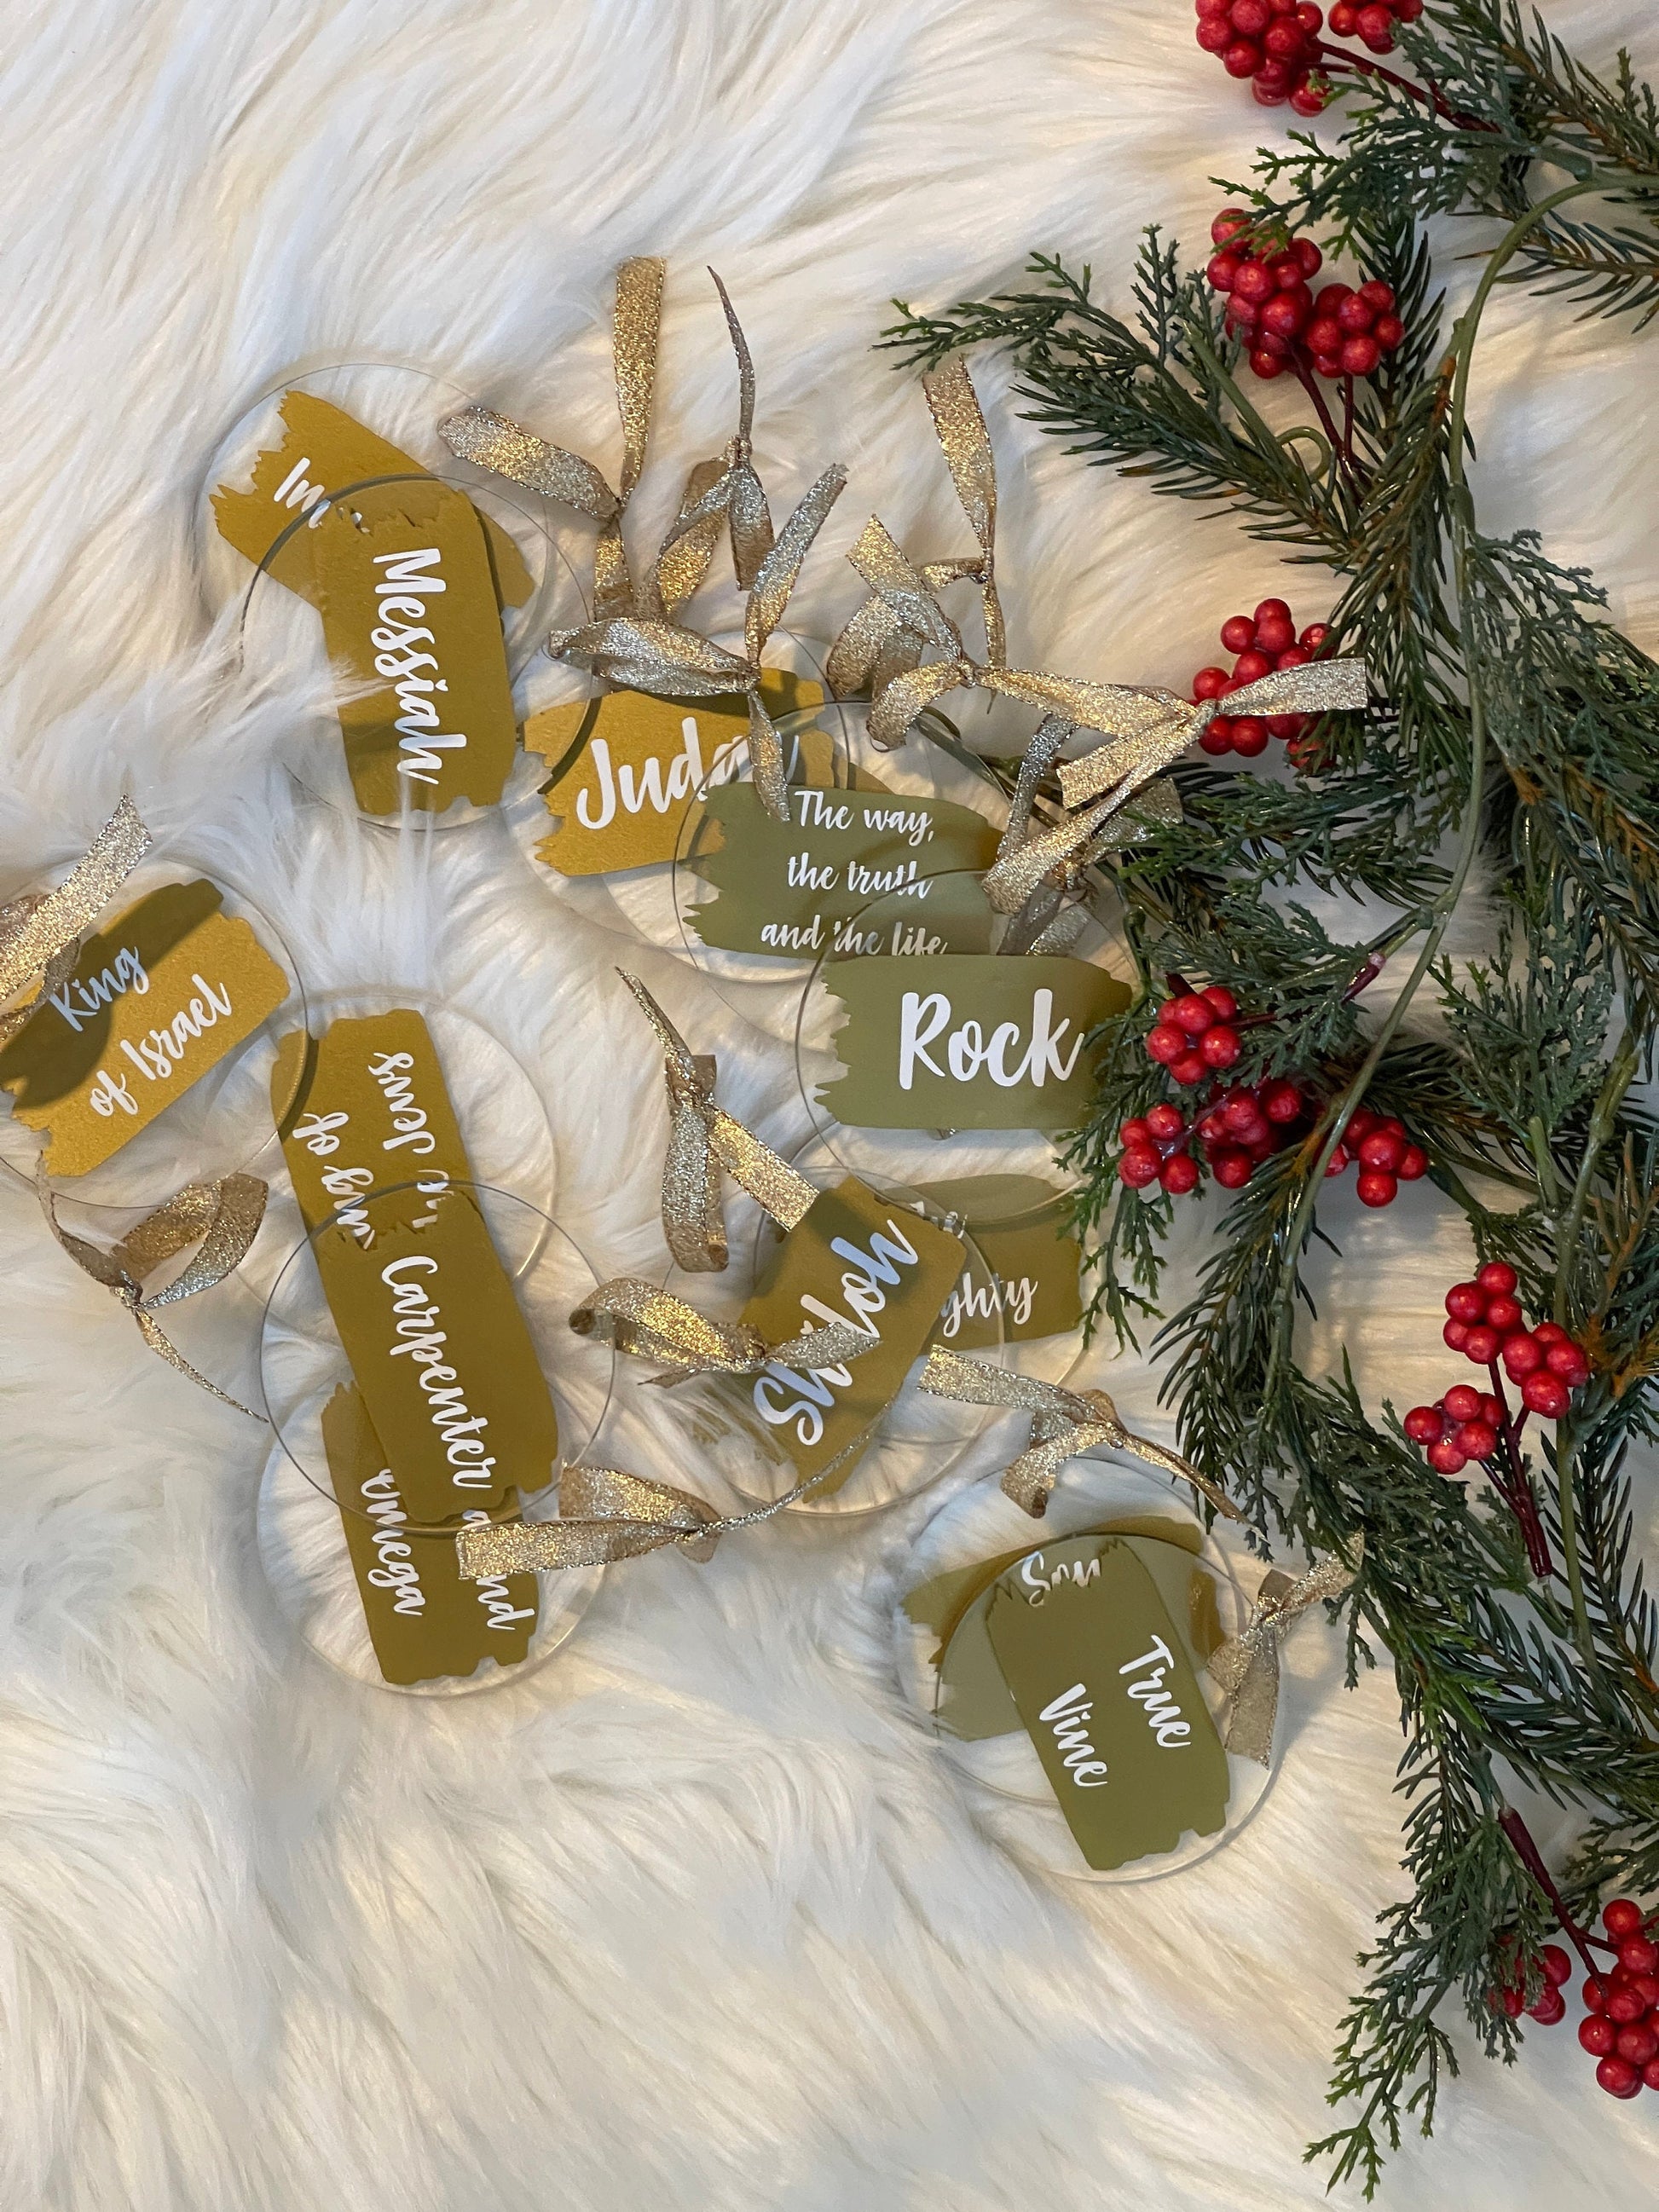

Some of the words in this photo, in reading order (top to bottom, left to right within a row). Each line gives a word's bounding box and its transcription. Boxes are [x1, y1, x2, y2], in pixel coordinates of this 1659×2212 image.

[372, 548, 466, 784] Messiah
[576, 717, 799, 829] Juda
[794, 790, 854, 829] The
[864, 806, 935, 846] way,
[787, 852, 840, 890] the
[847, 861, 932, 899] truth
[761, 915, 825, 950] and
[833, 915, 884, 955] the
[49, 944, 149, 1031] King
[90, 1071, 137, 1116] of
[120, 973, 232, 1082] Israel
[899, 989, 1084, 1090] Rock
[292, 1112, 349, 1155] of
[368, 1051, 436, 1154] Jews
[321, 1166, 374, 1250] ing
[381, 1256, 495, 1490] Carpenter
[1039, 1684, 1107, 1788] Vine
[1119, 1635, 1191, 1747] True
